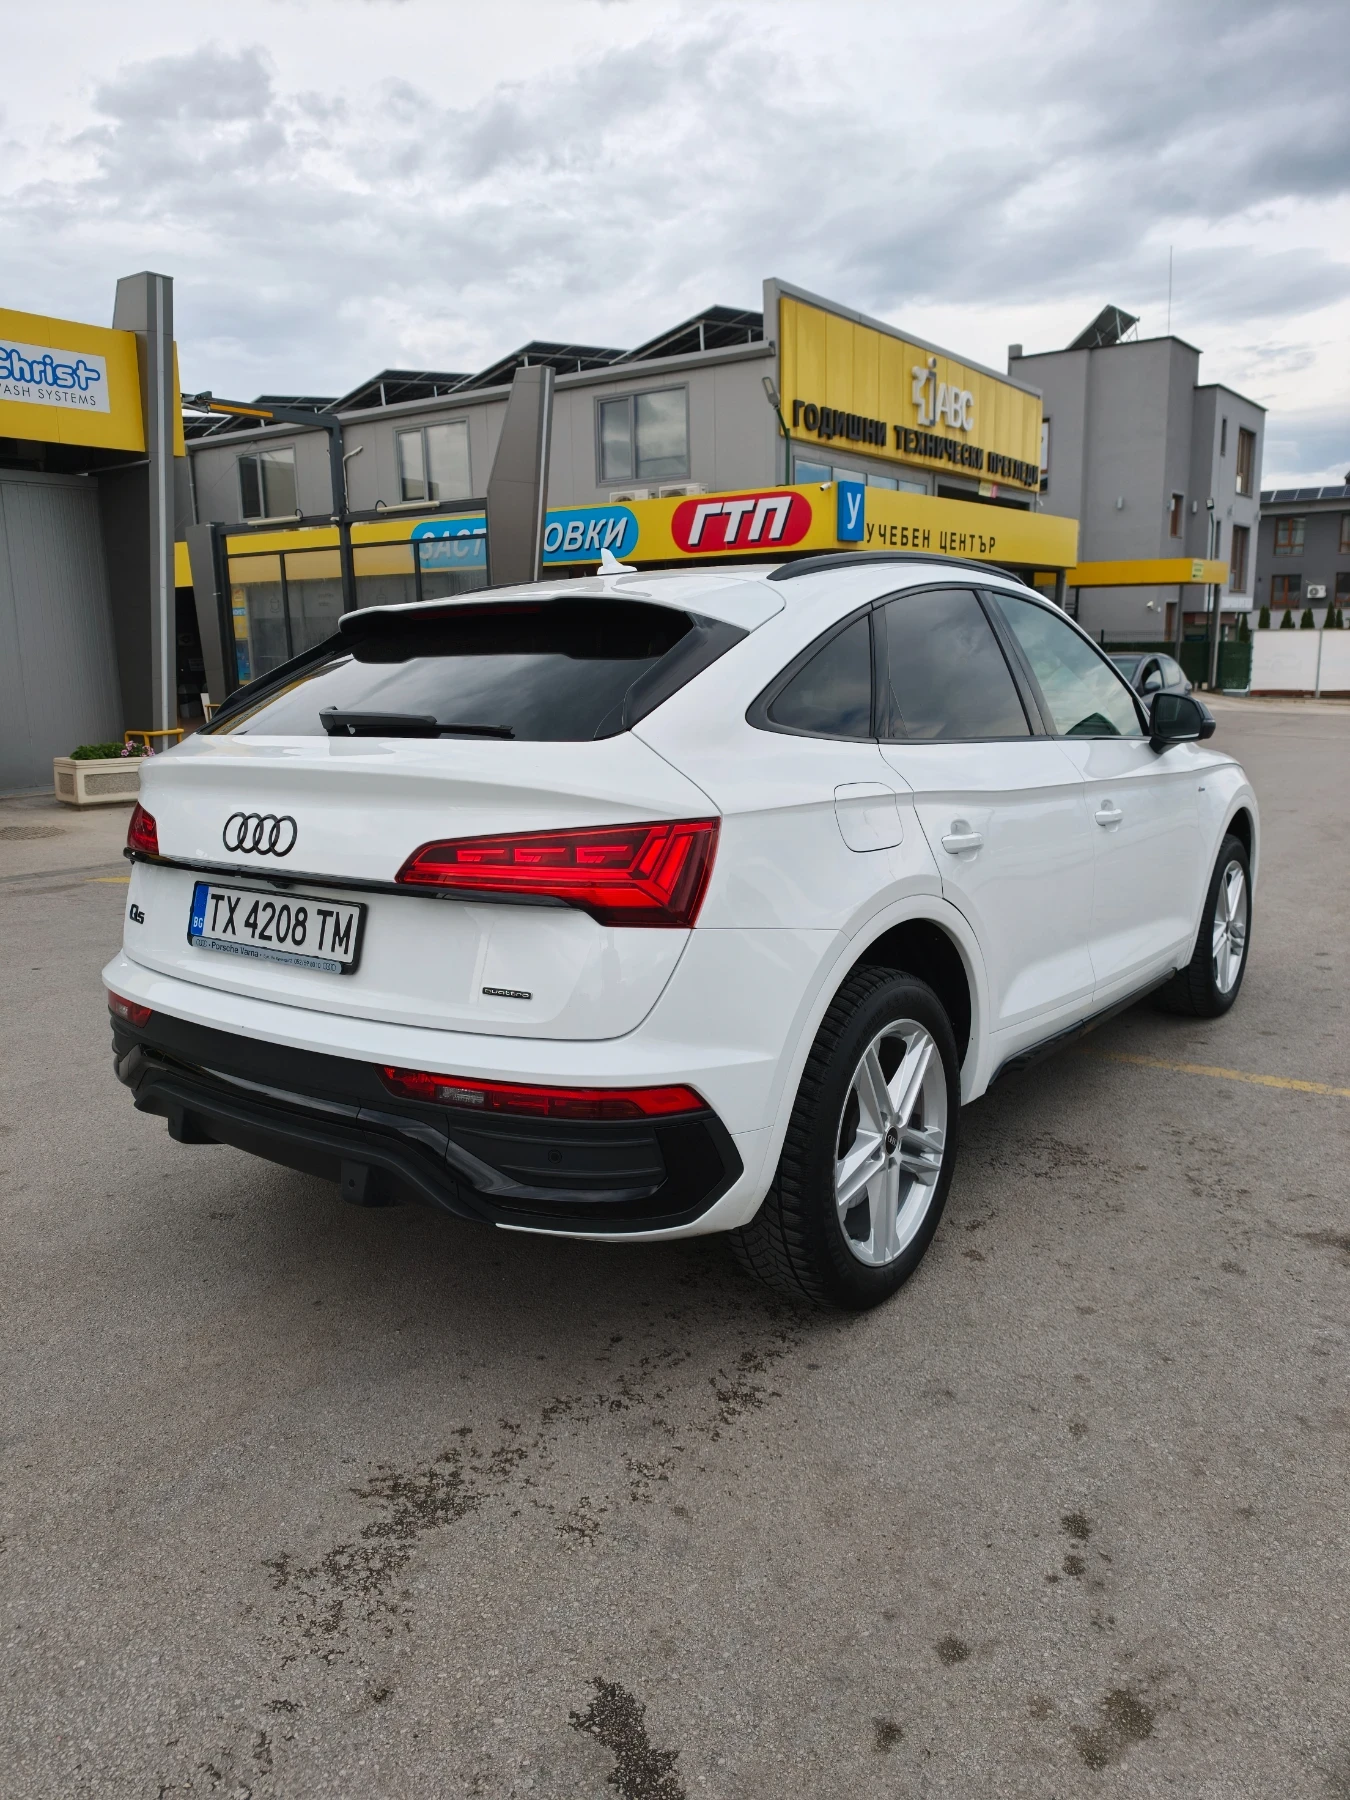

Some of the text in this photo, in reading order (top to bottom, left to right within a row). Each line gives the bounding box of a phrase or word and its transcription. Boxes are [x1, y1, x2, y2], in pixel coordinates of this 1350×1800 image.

[0, 383, 96, 406] ASH SYSTEMS
[792, 399, 1039, 487] ГОДИШНИ ТЕХНИЧЕСКИ ПРЕГЛЕДИ
[687, 496, 793, 547] ГТП
[847, 492, 862, 530] У
[866, 523, 996, 554] УЧЕБЕН ЦЕНТЪР
[193, 916, 204, 928] BG
[211, 893, 354, 955] TX 4208 TM
[211, 941, 239, 954] Porsche
[240, 946, 259, 958] Varna
[484, 988, 530, 998] quattro
